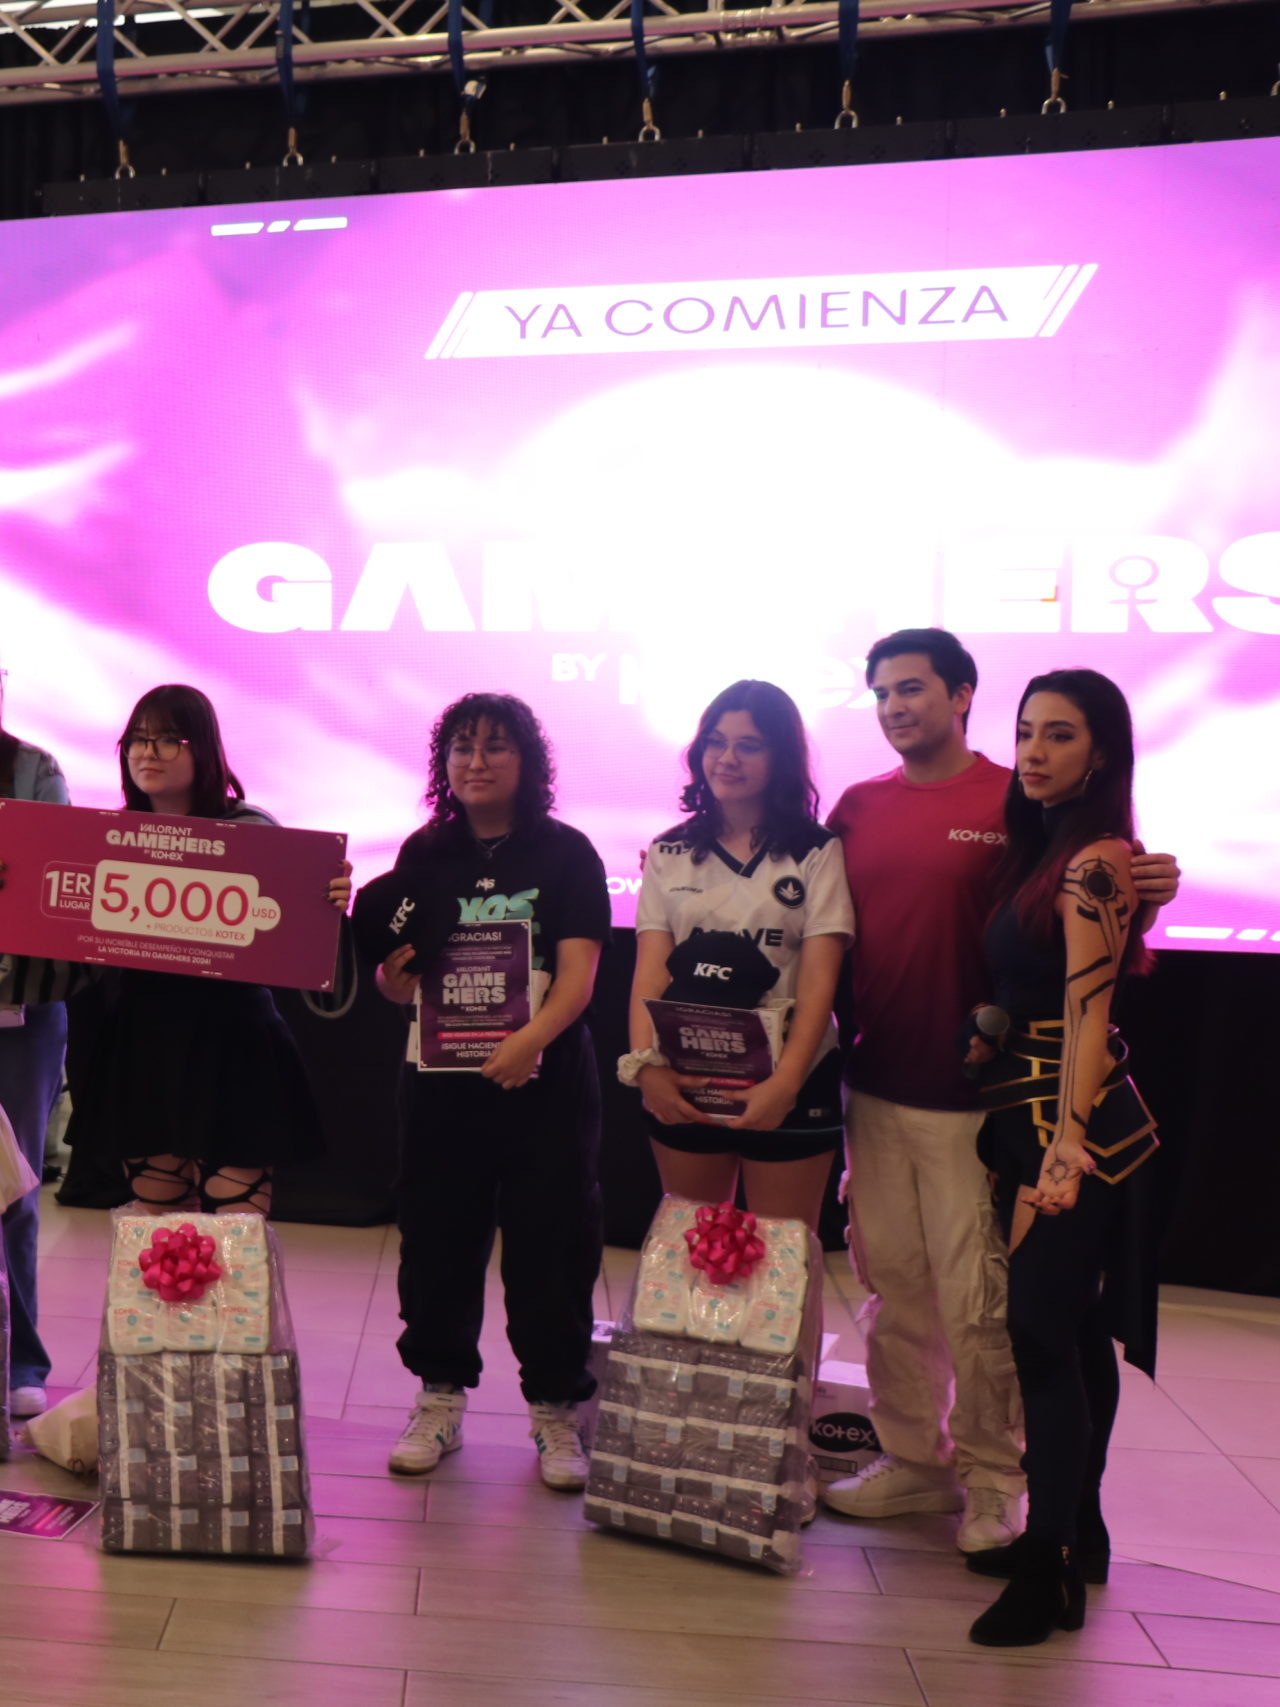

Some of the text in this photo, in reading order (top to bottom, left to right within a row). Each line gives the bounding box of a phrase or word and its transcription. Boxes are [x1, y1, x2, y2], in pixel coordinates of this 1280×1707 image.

[504, 284, 1009, 340] YA COMIENZA
[551, 653, 607, 682] BY
[140, 823, 193, 836] VALORANT
[106, 829, 225, 857] GAMEHERS
[60, 900, 91, 911] LUGAR
[100, 872, 277, 926] 5,000 USD
[389, 897, 416, 935] KFC
[154, 922, 214, 938] PRODUCTOS
[215, 931, 246, 941] KOTEX
[107, 947, 140, 957] VICTORIA
[141, 950, 151, 958] EN
[152, 951, 191, 963] GAMEHERS
[188, 947, 235, 960] CONQUISTAR
[442, 972, 507, 988] GAME
[693, 962, 733, 981] KFC
[442, 986, 507, 1005] HERS
[679, 1027, 745, 1041] GAME
[468, 1041, 500, 1050] HACIEN
[681, 1036, 748, 1054] HERS
